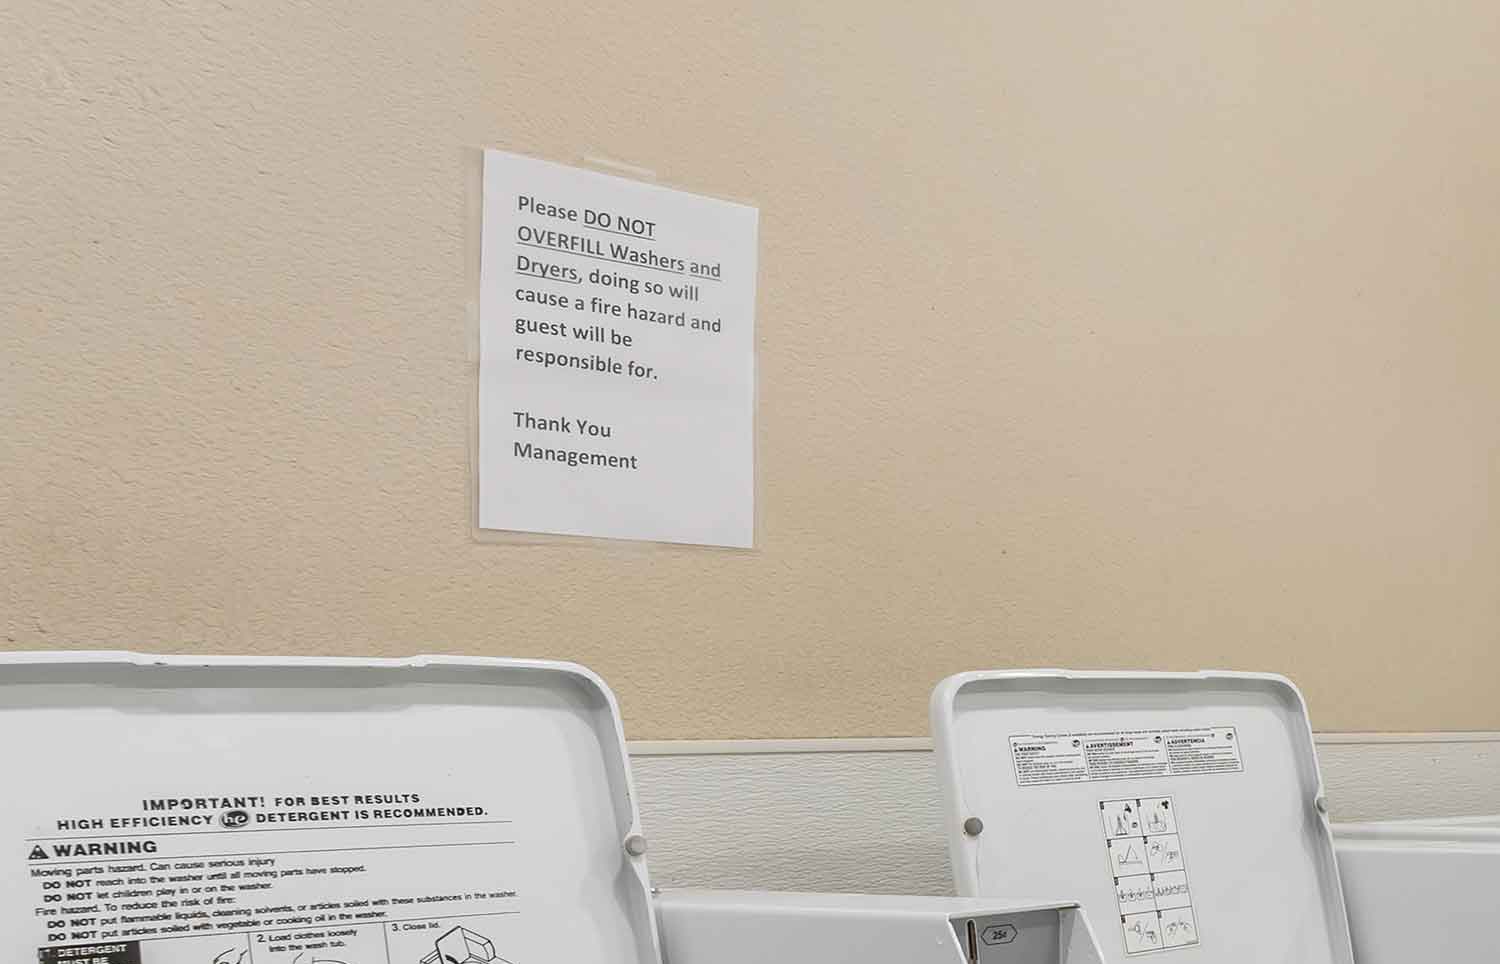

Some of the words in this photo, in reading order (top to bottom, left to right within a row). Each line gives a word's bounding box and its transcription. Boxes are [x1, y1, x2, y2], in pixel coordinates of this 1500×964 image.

[518, 195, 578, 221] Please
[584, 208, 612, 228] DO
[617, 215, 656, 236] NOT
[517, 226, 605, 255] OVERFILL
[609, 243, 685, 270] Washers
[690, 261, 721, 277] and
[516, 255, 583, 284] Dryers,
[588, 269, 640, 294] doing
[644, 281, 664, 295] so
[668, 284, 698, 301] will
[515, 288, 569, 308] cause
[574, 297, 585, 311] a
[590, 297, 622, 317] fire
[627, 303, 685, 326] hazard
[690, 317, 721, 333] and
[514, 318, 567, 336] guest
[572, 325, 605, 342] will
[610, 328, 632, 347] be
[516, 348, 622, 374] responsible
[627, 360, 657, 379] for.
[512, 411, 571, 432] Thank
[576, 419, 611, 438] You
[514, 442, 638, 468] Management
[142, 797, 264, 810] IMPORTANT!
[274, 796, 306, 806] FOR
[310, 795, 349, 805] BEST
[353, 793, 420, 804] RESULTS
[56, 819, 103, 830] HIGH
[109, 816, 212, 828] EFFICIENCY
[255, 810, 350, 822] DETERGENT
[354, 809, 369, 819] IS
[372, 807, 488, 818] RECOMMENDED.
[52, 841, 157, 856] WARNING
[57, 944, 127, 956] DETERGENT
